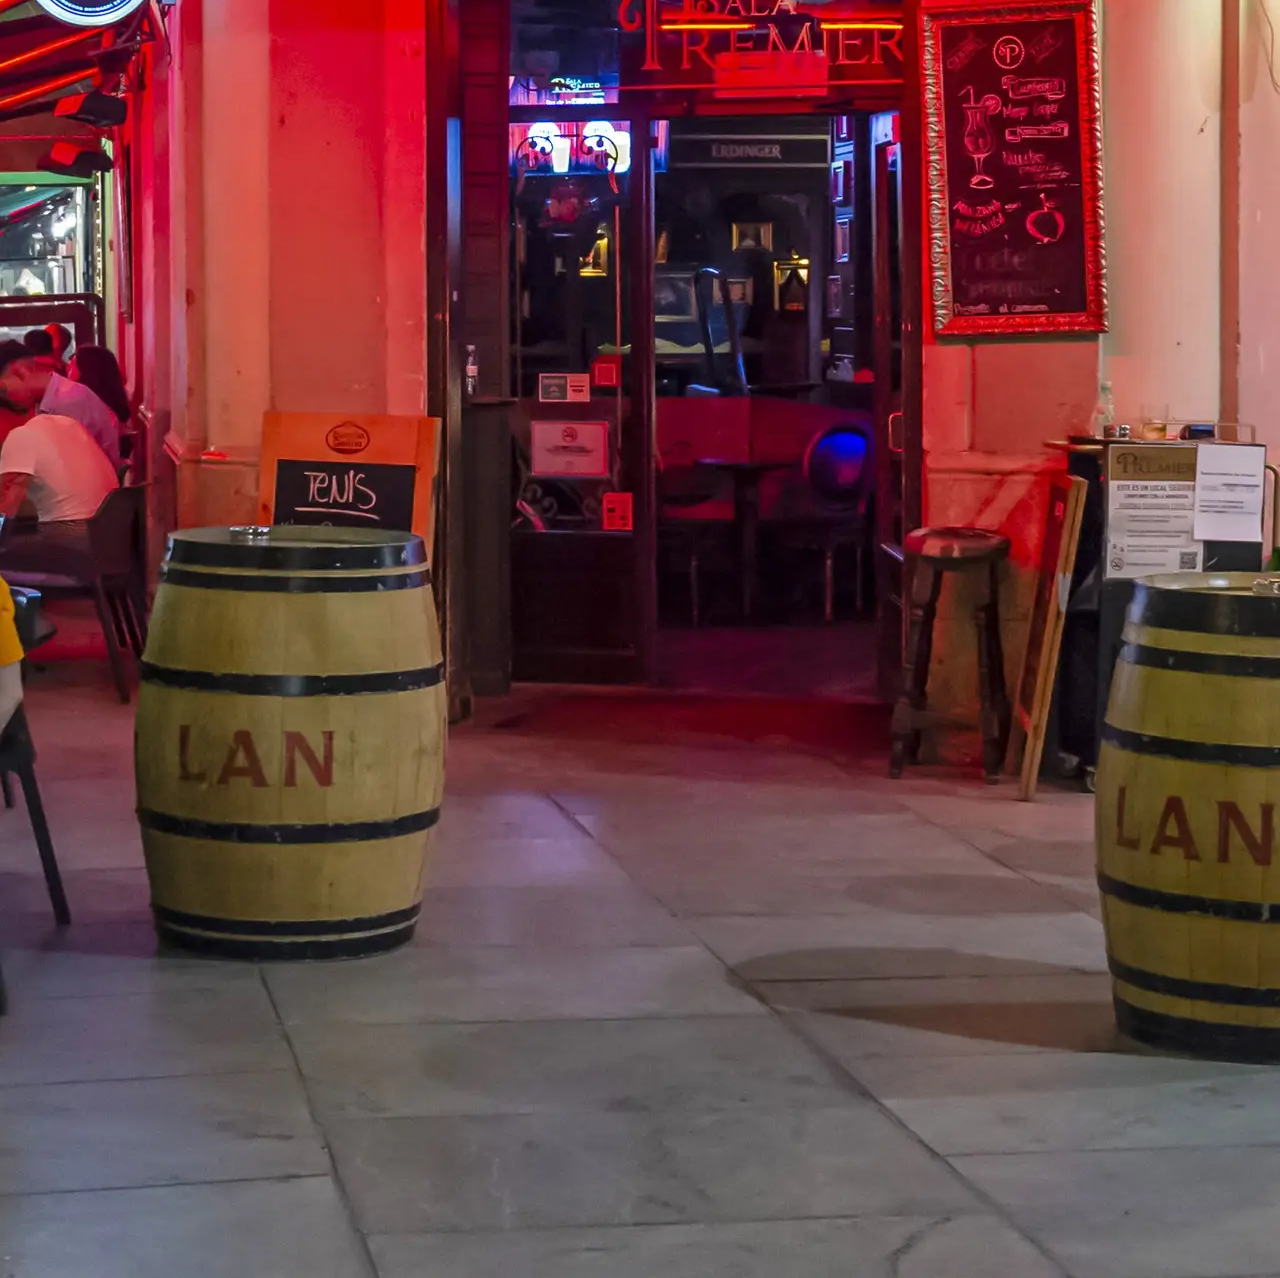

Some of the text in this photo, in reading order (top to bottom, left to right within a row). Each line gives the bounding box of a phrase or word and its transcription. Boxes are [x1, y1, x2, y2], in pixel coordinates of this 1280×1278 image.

[710, 143, 782, 160] ERDINGER
[178, 724, 337, 789] LAN
[1115, 785, 1276, 867] LAN
